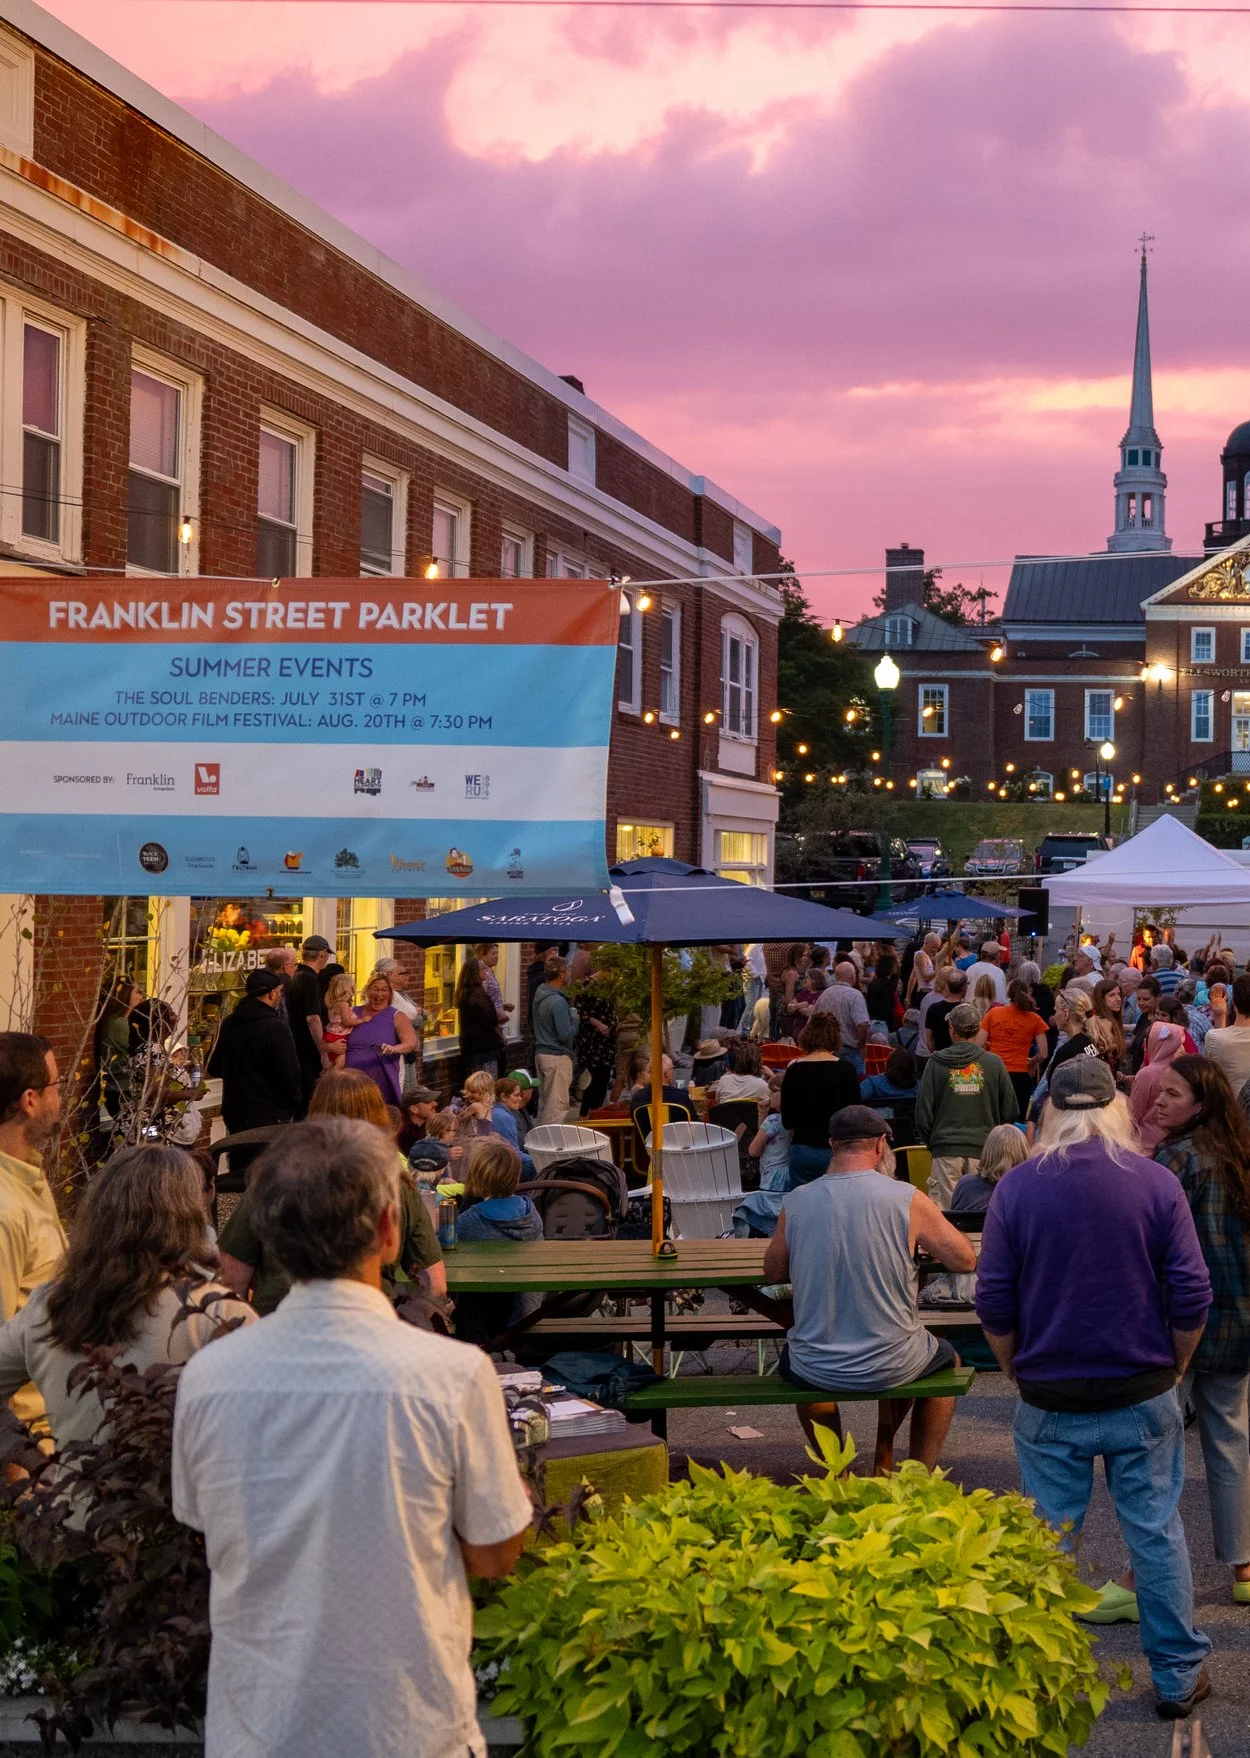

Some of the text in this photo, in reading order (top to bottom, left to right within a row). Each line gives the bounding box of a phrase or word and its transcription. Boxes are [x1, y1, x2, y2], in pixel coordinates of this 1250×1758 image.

[49, 600, 513, 631] FRANKLIN STREET PARKLET
[169, 657, 373, 678] SUMMER EVENTS
[115, 690, 427, 709] THE SOUL BENDERS: JULY 31ST @ 7 PM
[50, 711, 493, 731] MAINE OUTDOOR FILM FESTIVAL: AUG. 20TH @ 7:30 PM
[53, 775, 115, 784] SPONSORED BY:
[126, 773, 175, 786] Franklin
[476, 914, 602, 923] SARATOGA
